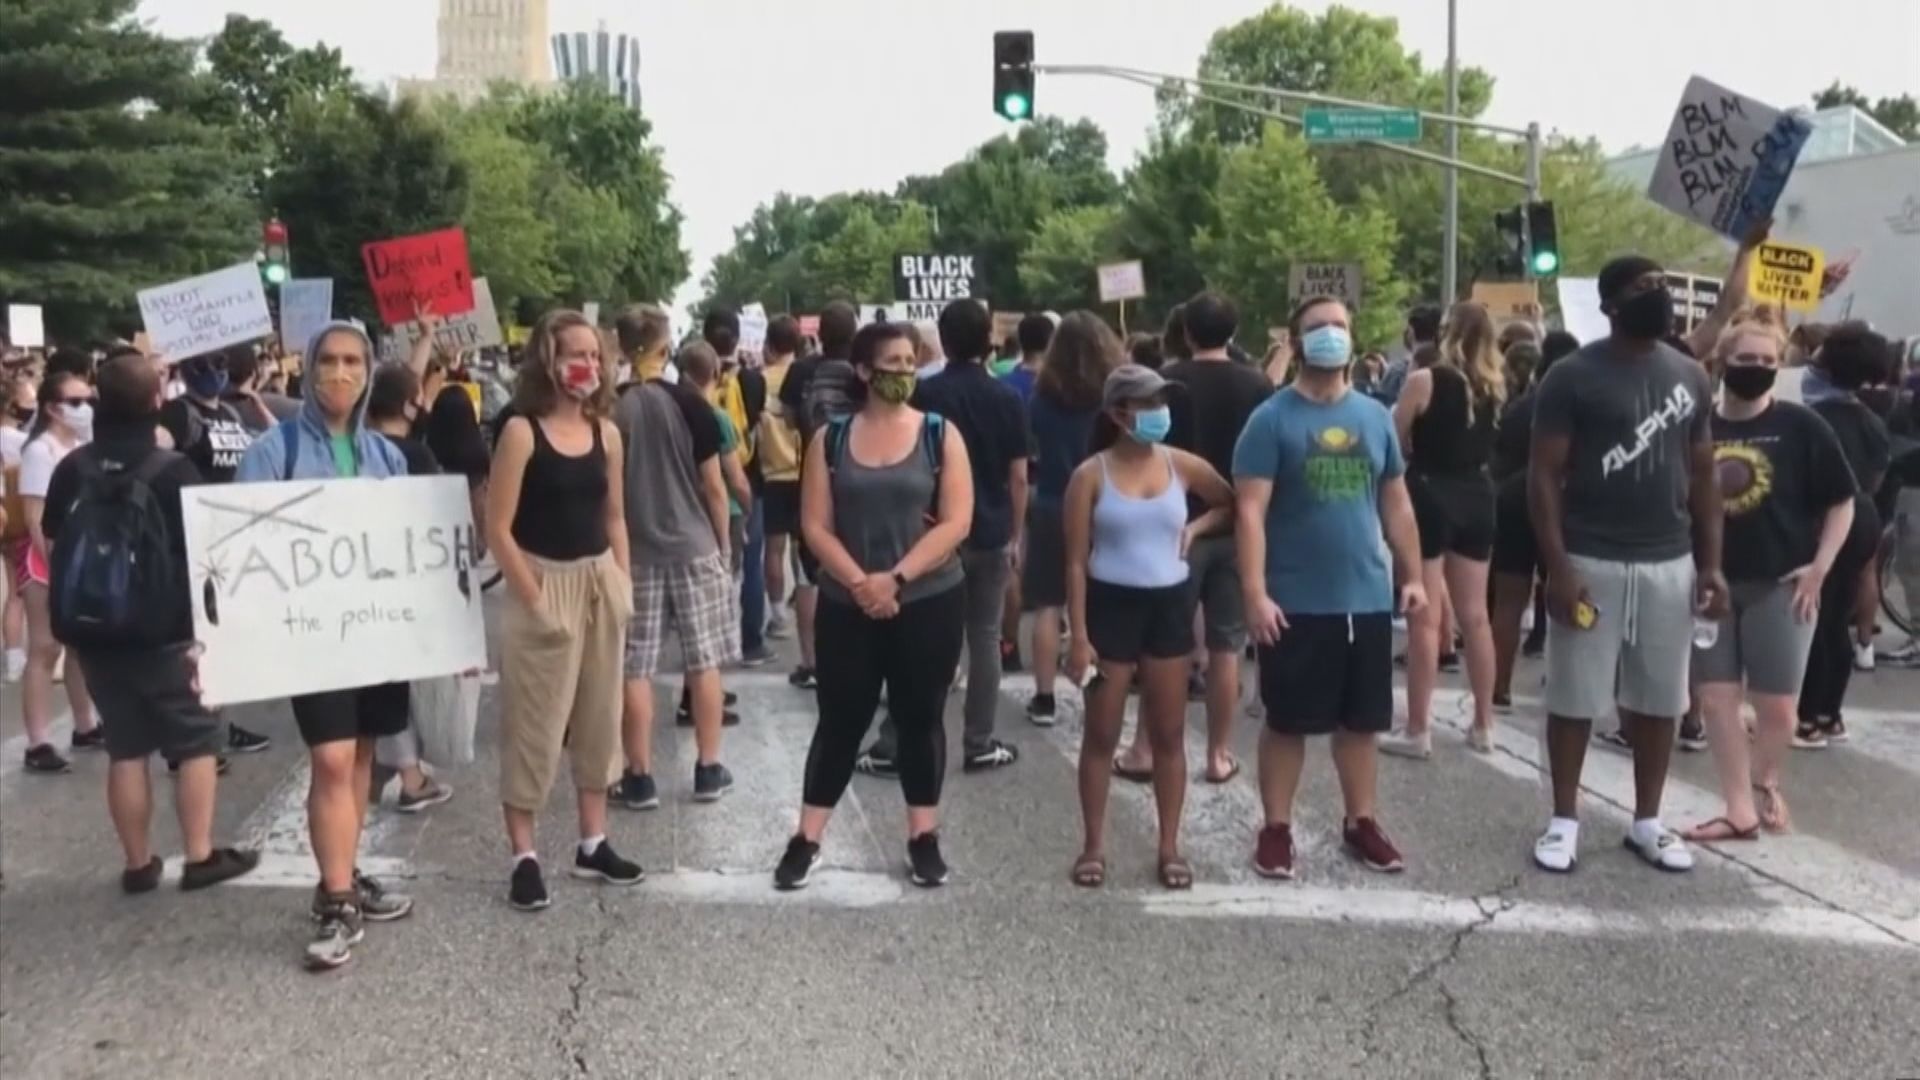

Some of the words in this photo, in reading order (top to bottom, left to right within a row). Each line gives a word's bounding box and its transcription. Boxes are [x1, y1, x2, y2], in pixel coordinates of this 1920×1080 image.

[1681, 96, 1748, 135] BLM
[1673, 124, 1739, 169] BLM
[1680, 155, 1743, 208] BLM
[901, 255, 975, 278] BLACK
[1762, 249, 1808, 269] BLACK
[1306, 266, 1346, 281] BLACK
[1763, 270, 1802, 287] LIVES
[909, 278, 971, 299] LIVES
[1300, 281, 1348, 296] LIVES
[1757, 281, 1809, 299] MATTER
[1602, 384, 1695, 480] ALPHA
[231, 524, 478, 597] ABOLISH
[283, 606, 323, 636] the
[341, 603, 416, 641] police
